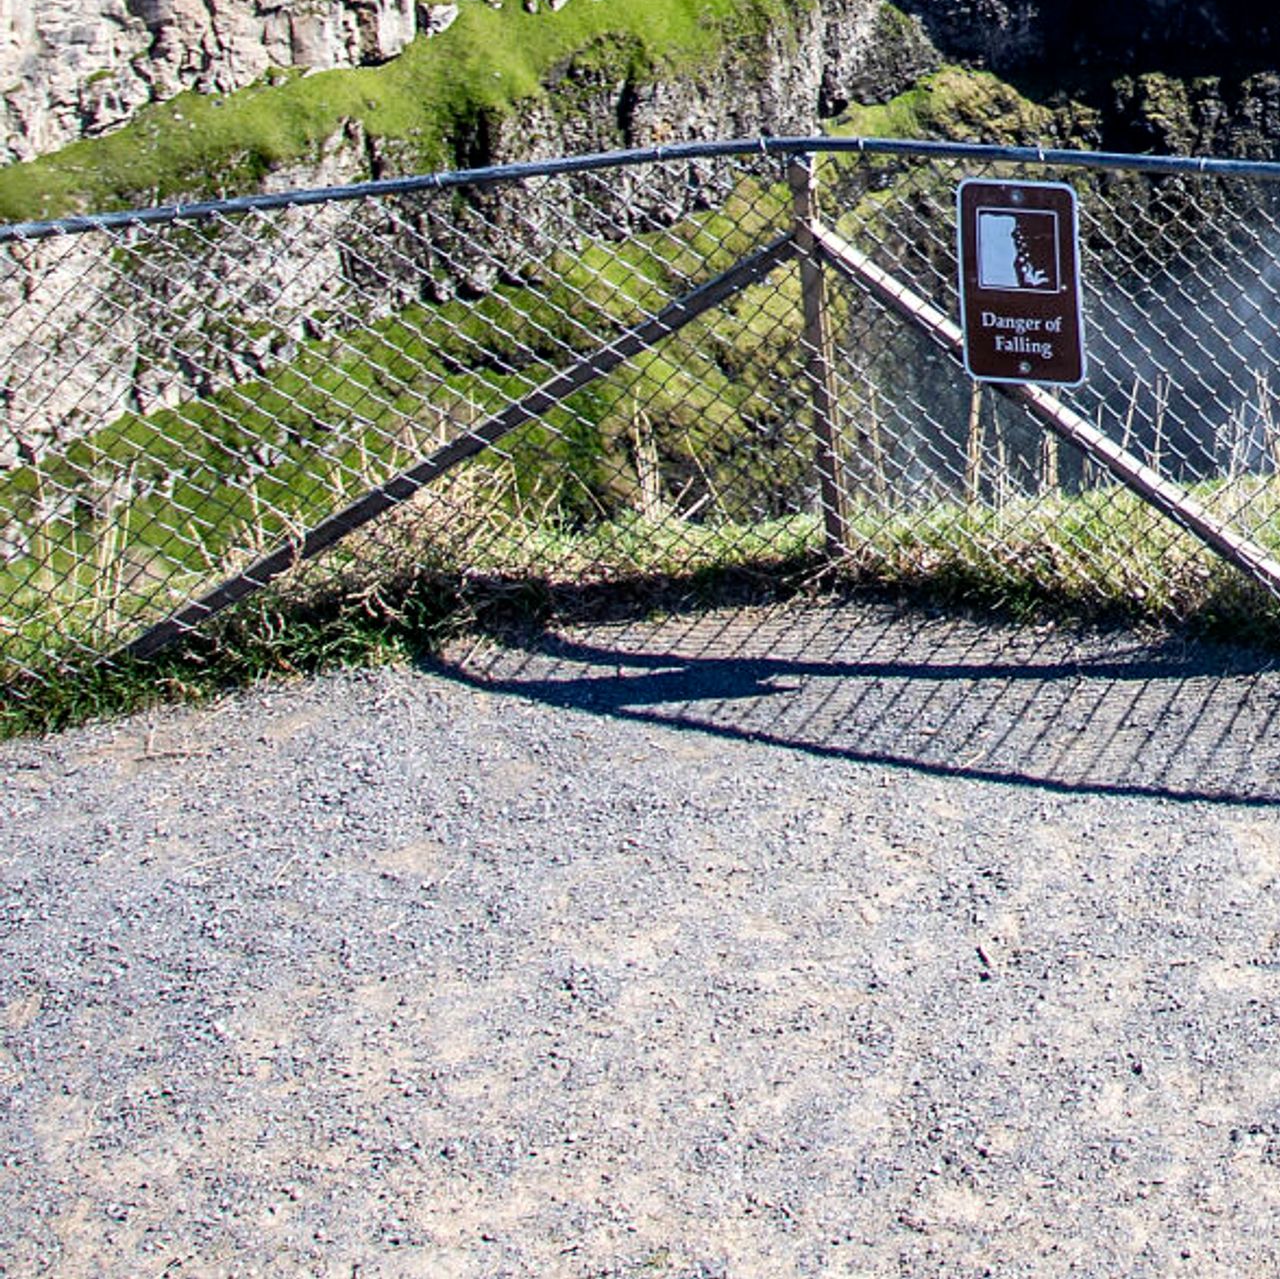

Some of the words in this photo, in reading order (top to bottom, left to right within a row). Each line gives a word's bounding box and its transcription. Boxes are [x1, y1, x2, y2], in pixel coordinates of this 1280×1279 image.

[982, 312, 1041, 334] Danger
[1045, 316, 1062, 332] of
[995, 335, 1053, 359] Falling
